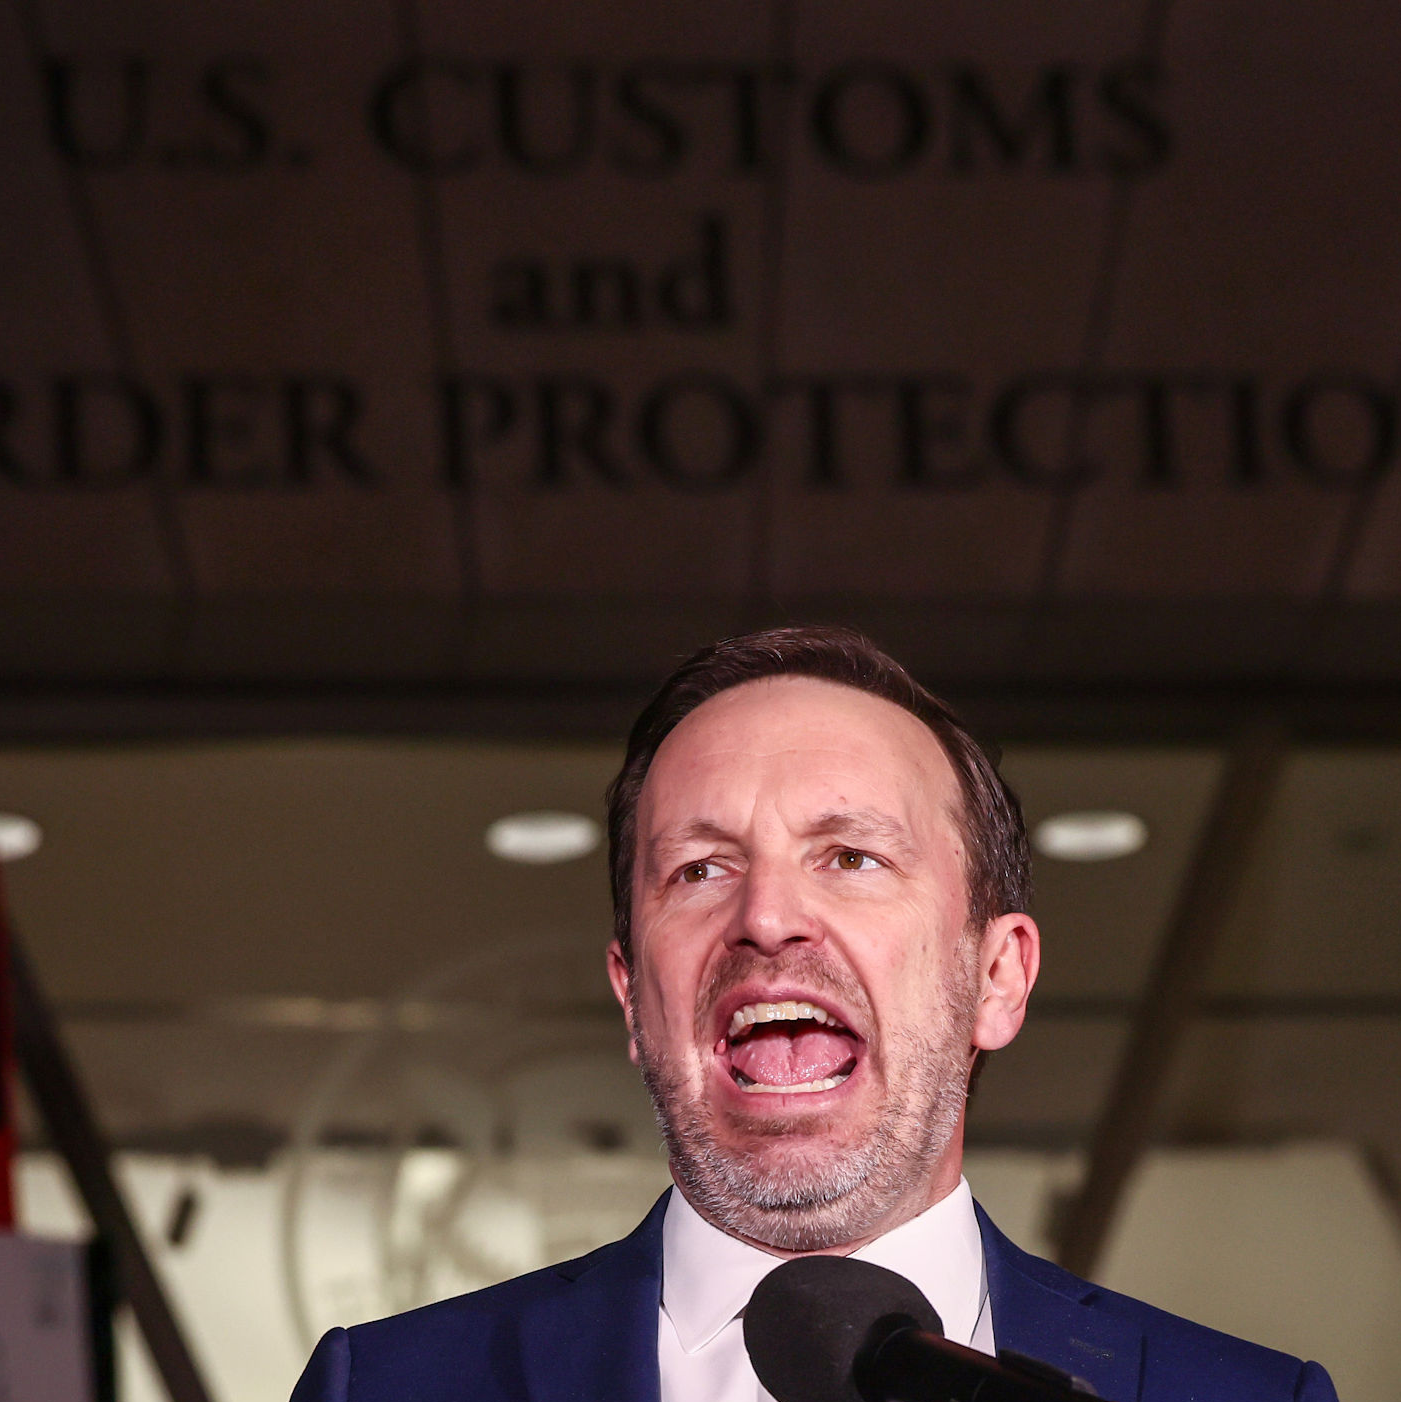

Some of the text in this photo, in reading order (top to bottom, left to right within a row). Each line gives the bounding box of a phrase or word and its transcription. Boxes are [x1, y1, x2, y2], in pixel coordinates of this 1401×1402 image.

[40, 52, 1174, 178] U.S. CUSTOMS
[488, 215, 736, 332] and
